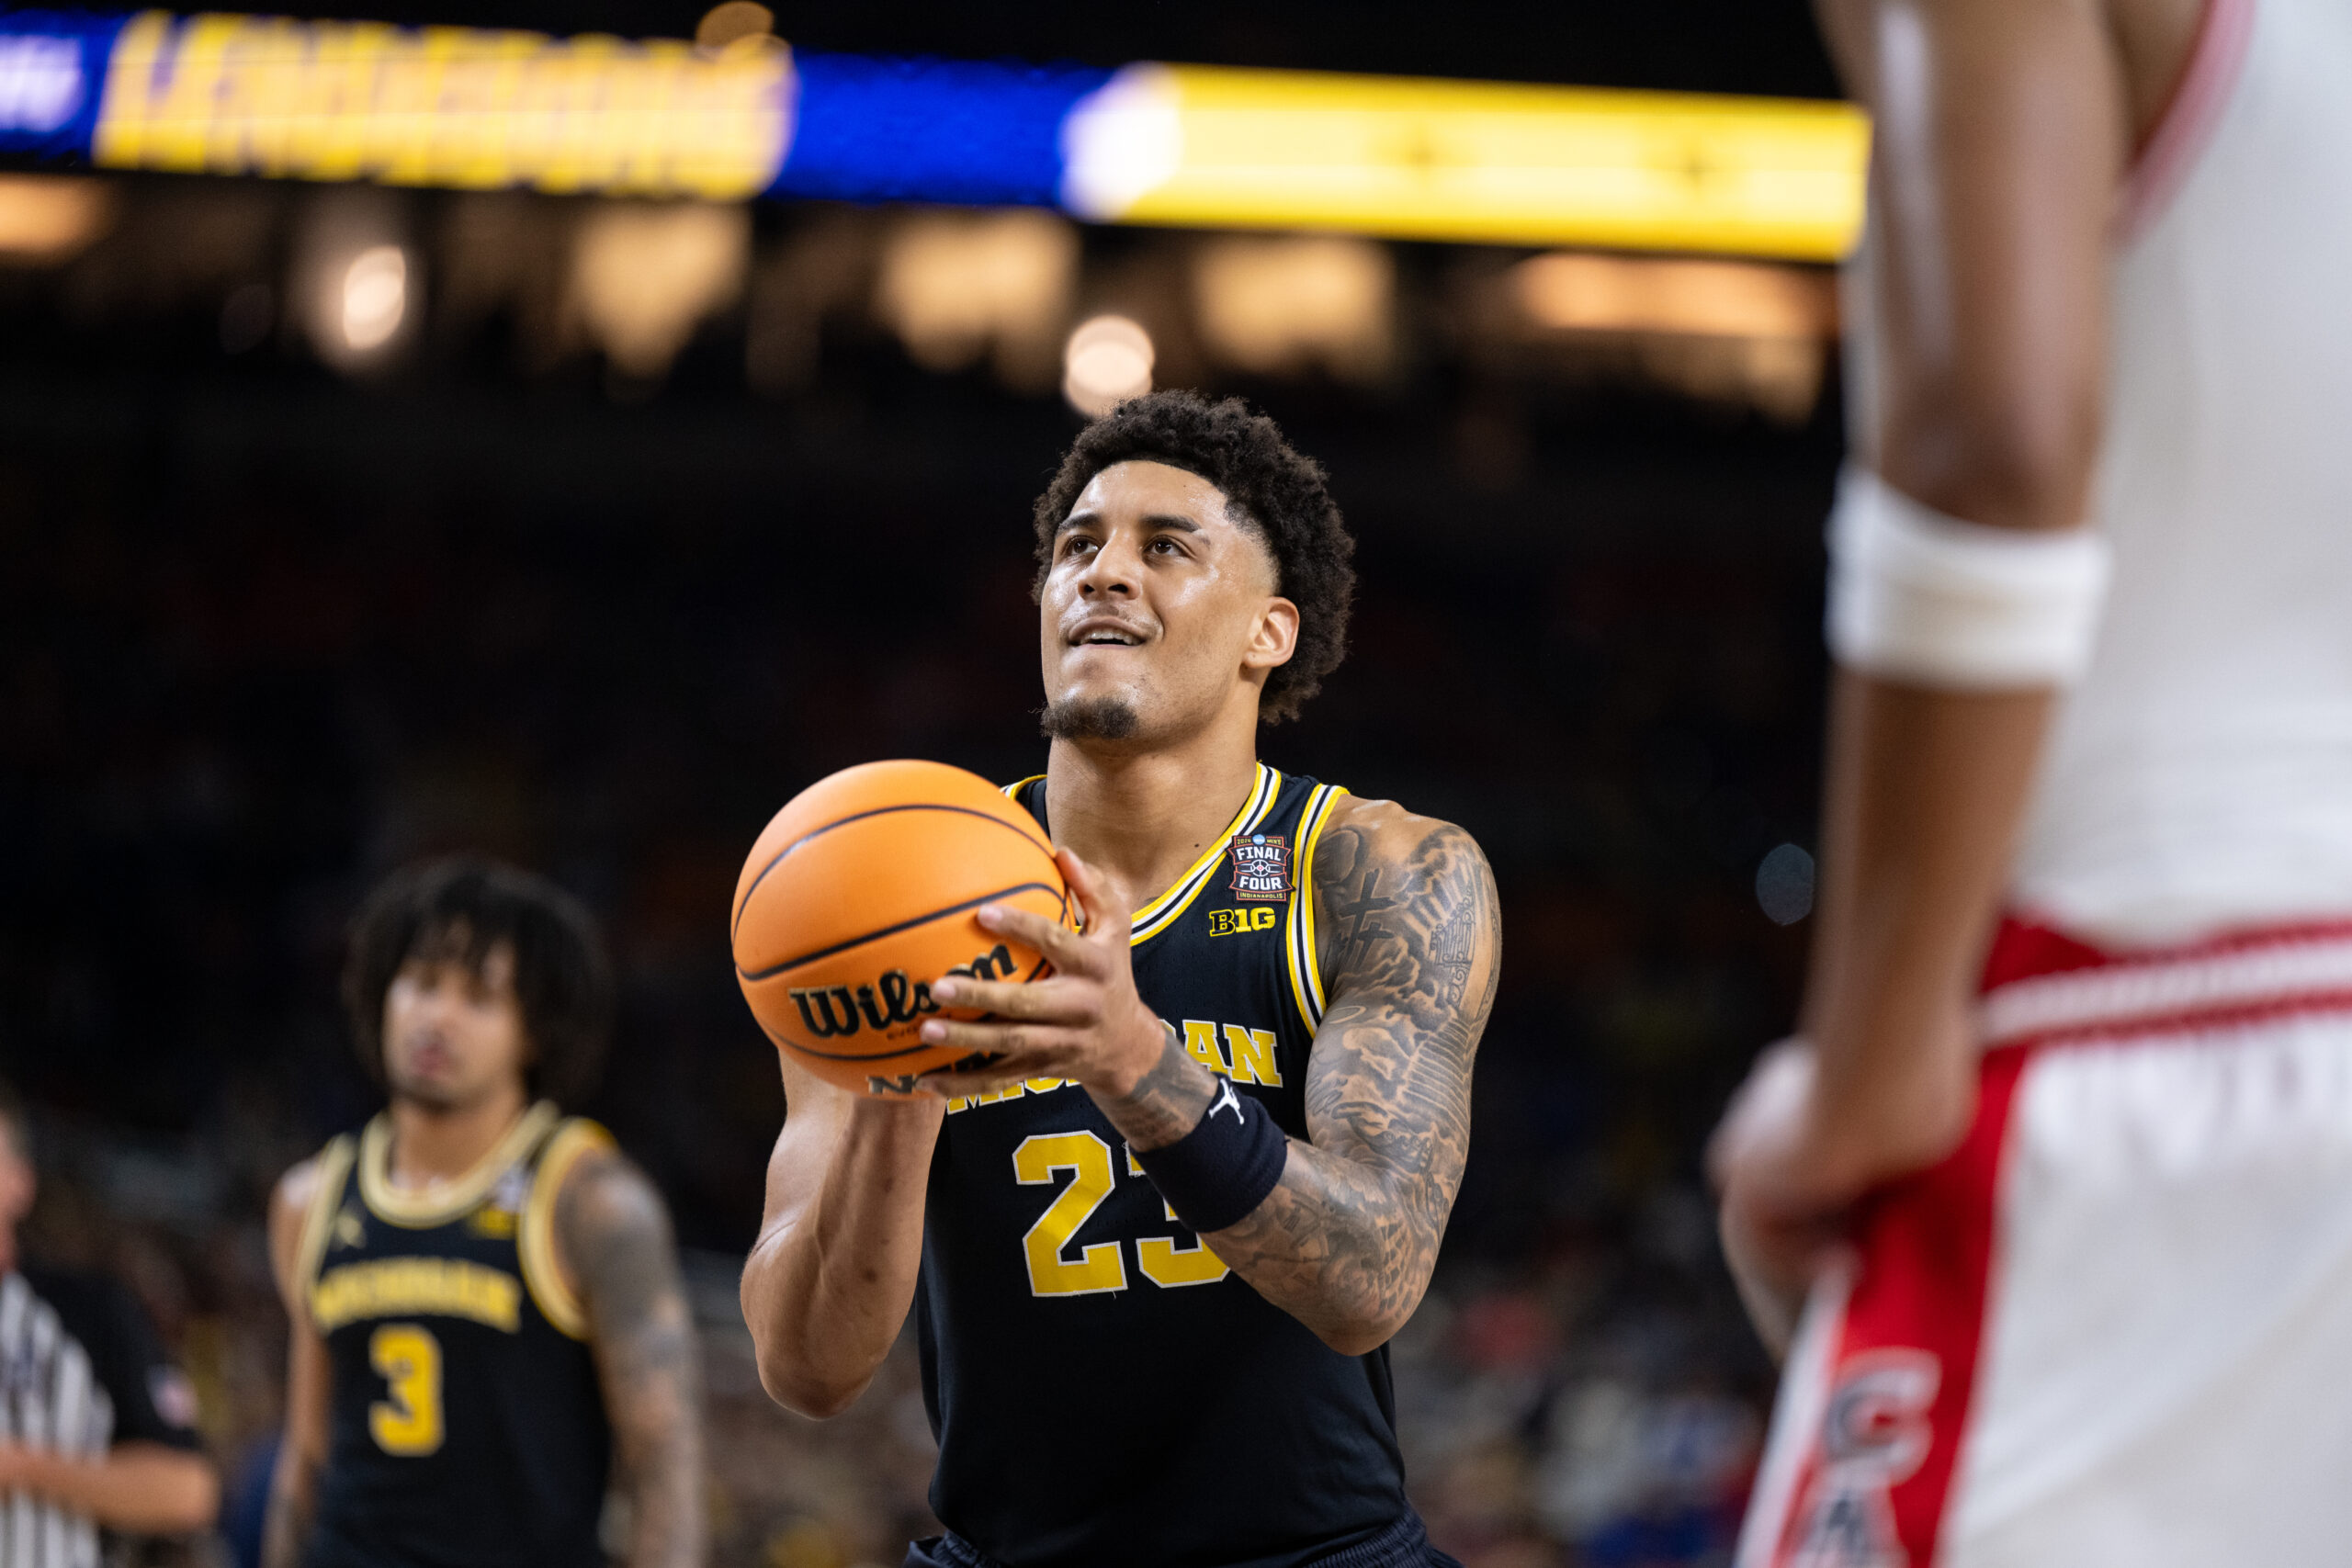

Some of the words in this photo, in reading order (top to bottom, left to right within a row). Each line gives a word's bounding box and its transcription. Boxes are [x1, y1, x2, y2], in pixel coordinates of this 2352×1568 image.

[1236, 846, 1282, 862] FINAL
[1238, 875, 1283, 891] FOUR
[369, 1322, 446, 1457] 3
